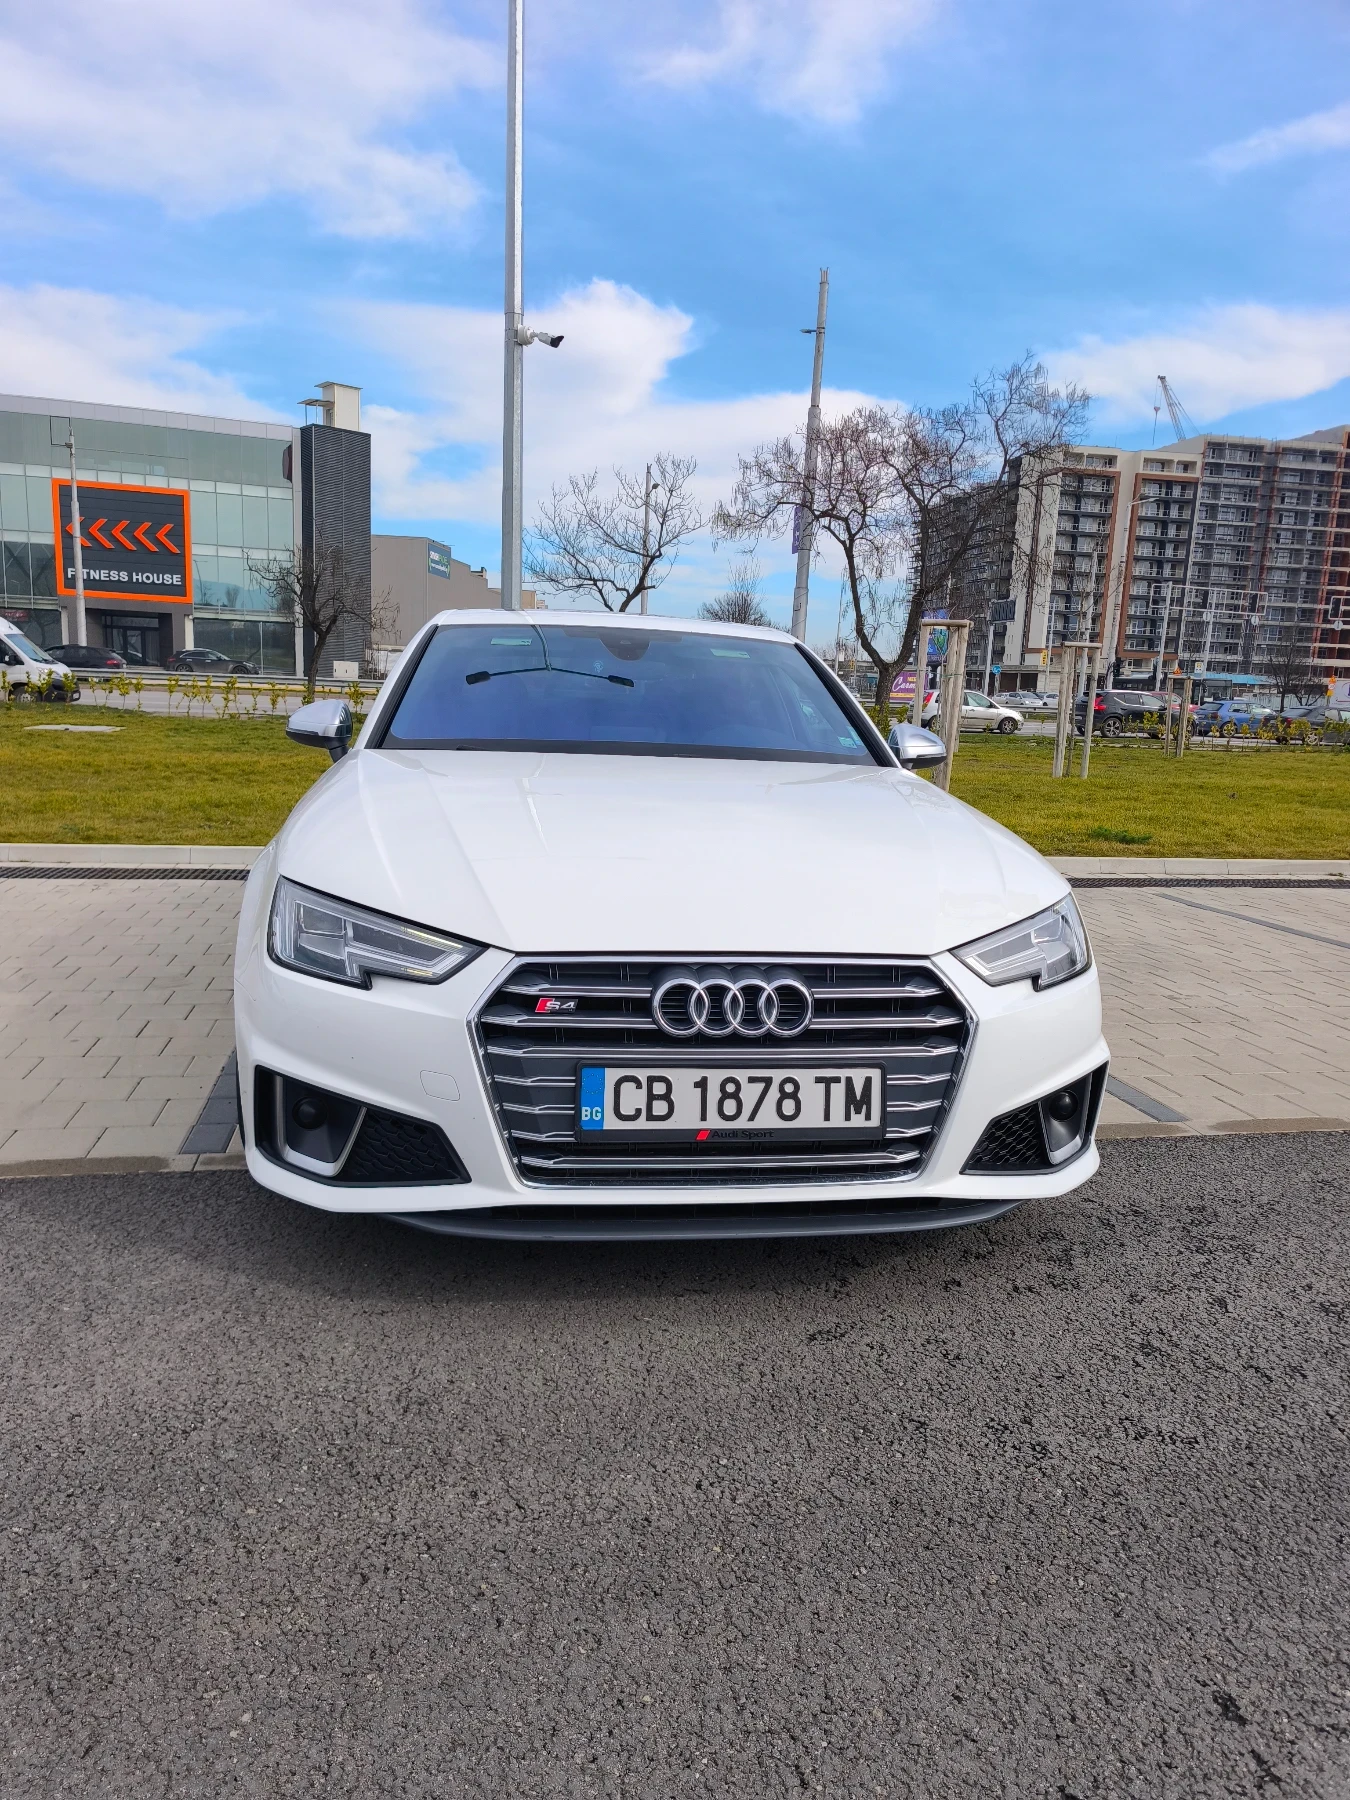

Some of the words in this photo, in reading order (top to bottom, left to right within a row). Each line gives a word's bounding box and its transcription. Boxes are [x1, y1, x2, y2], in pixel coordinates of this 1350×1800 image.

[67, 567, 128, 582] FTNESS
[132, 571, 181, 585] HOUSE
[545, 1001, 575, 1010] S4
[613, 1075, 675, 1121] CB
[693, 1076, 801, 1121] 1878
[814, 1076, 872, 1121] TM
[581, 1106, 602, 1120] BG
[712, 1130, 738, 1138] Audi
[741, 1130, 774, 1139] Sport
